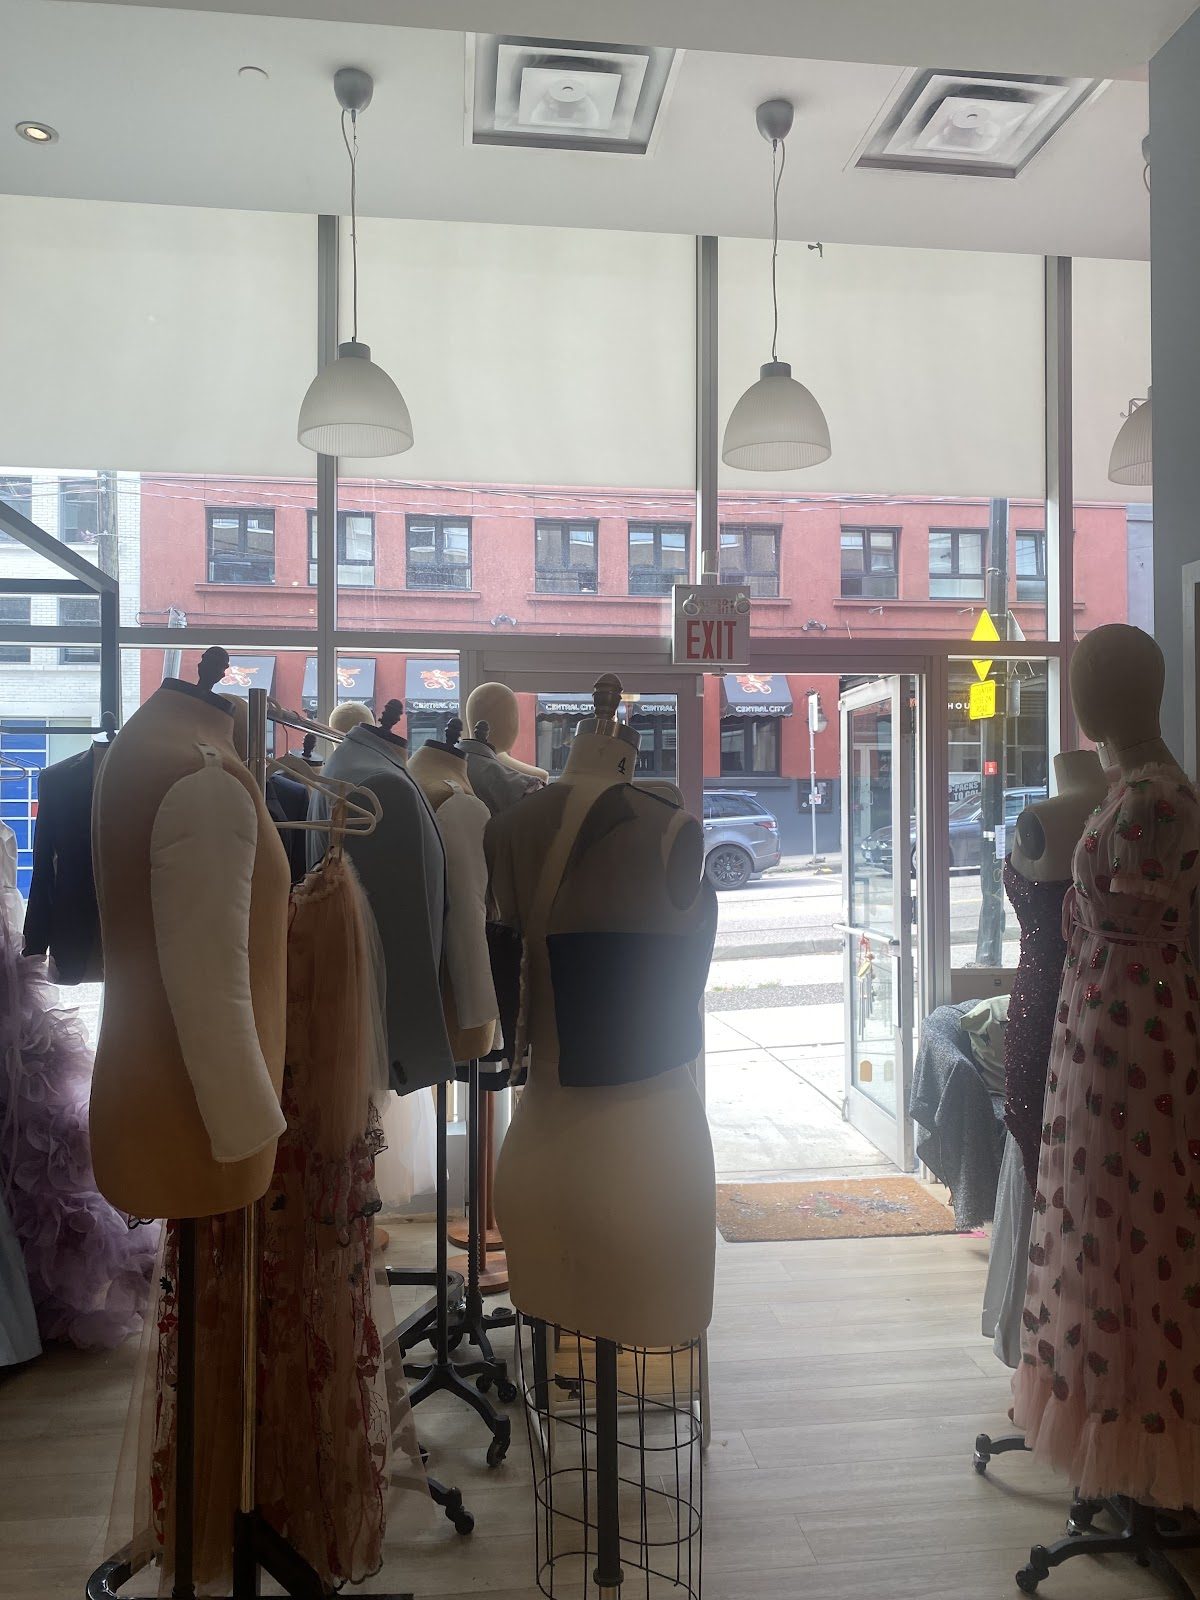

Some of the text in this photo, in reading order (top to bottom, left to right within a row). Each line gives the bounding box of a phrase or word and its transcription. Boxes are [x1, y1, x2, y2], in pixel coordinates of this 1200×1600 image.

[686, 620, 737, 660] EXIT
[545, 703, 579, 711] CENTRAL
[640, 704, 675, 712] CENTRAL
[735, 705, 786, 713] CENTRAL CITY
[617, 756, 626, 775] 4
